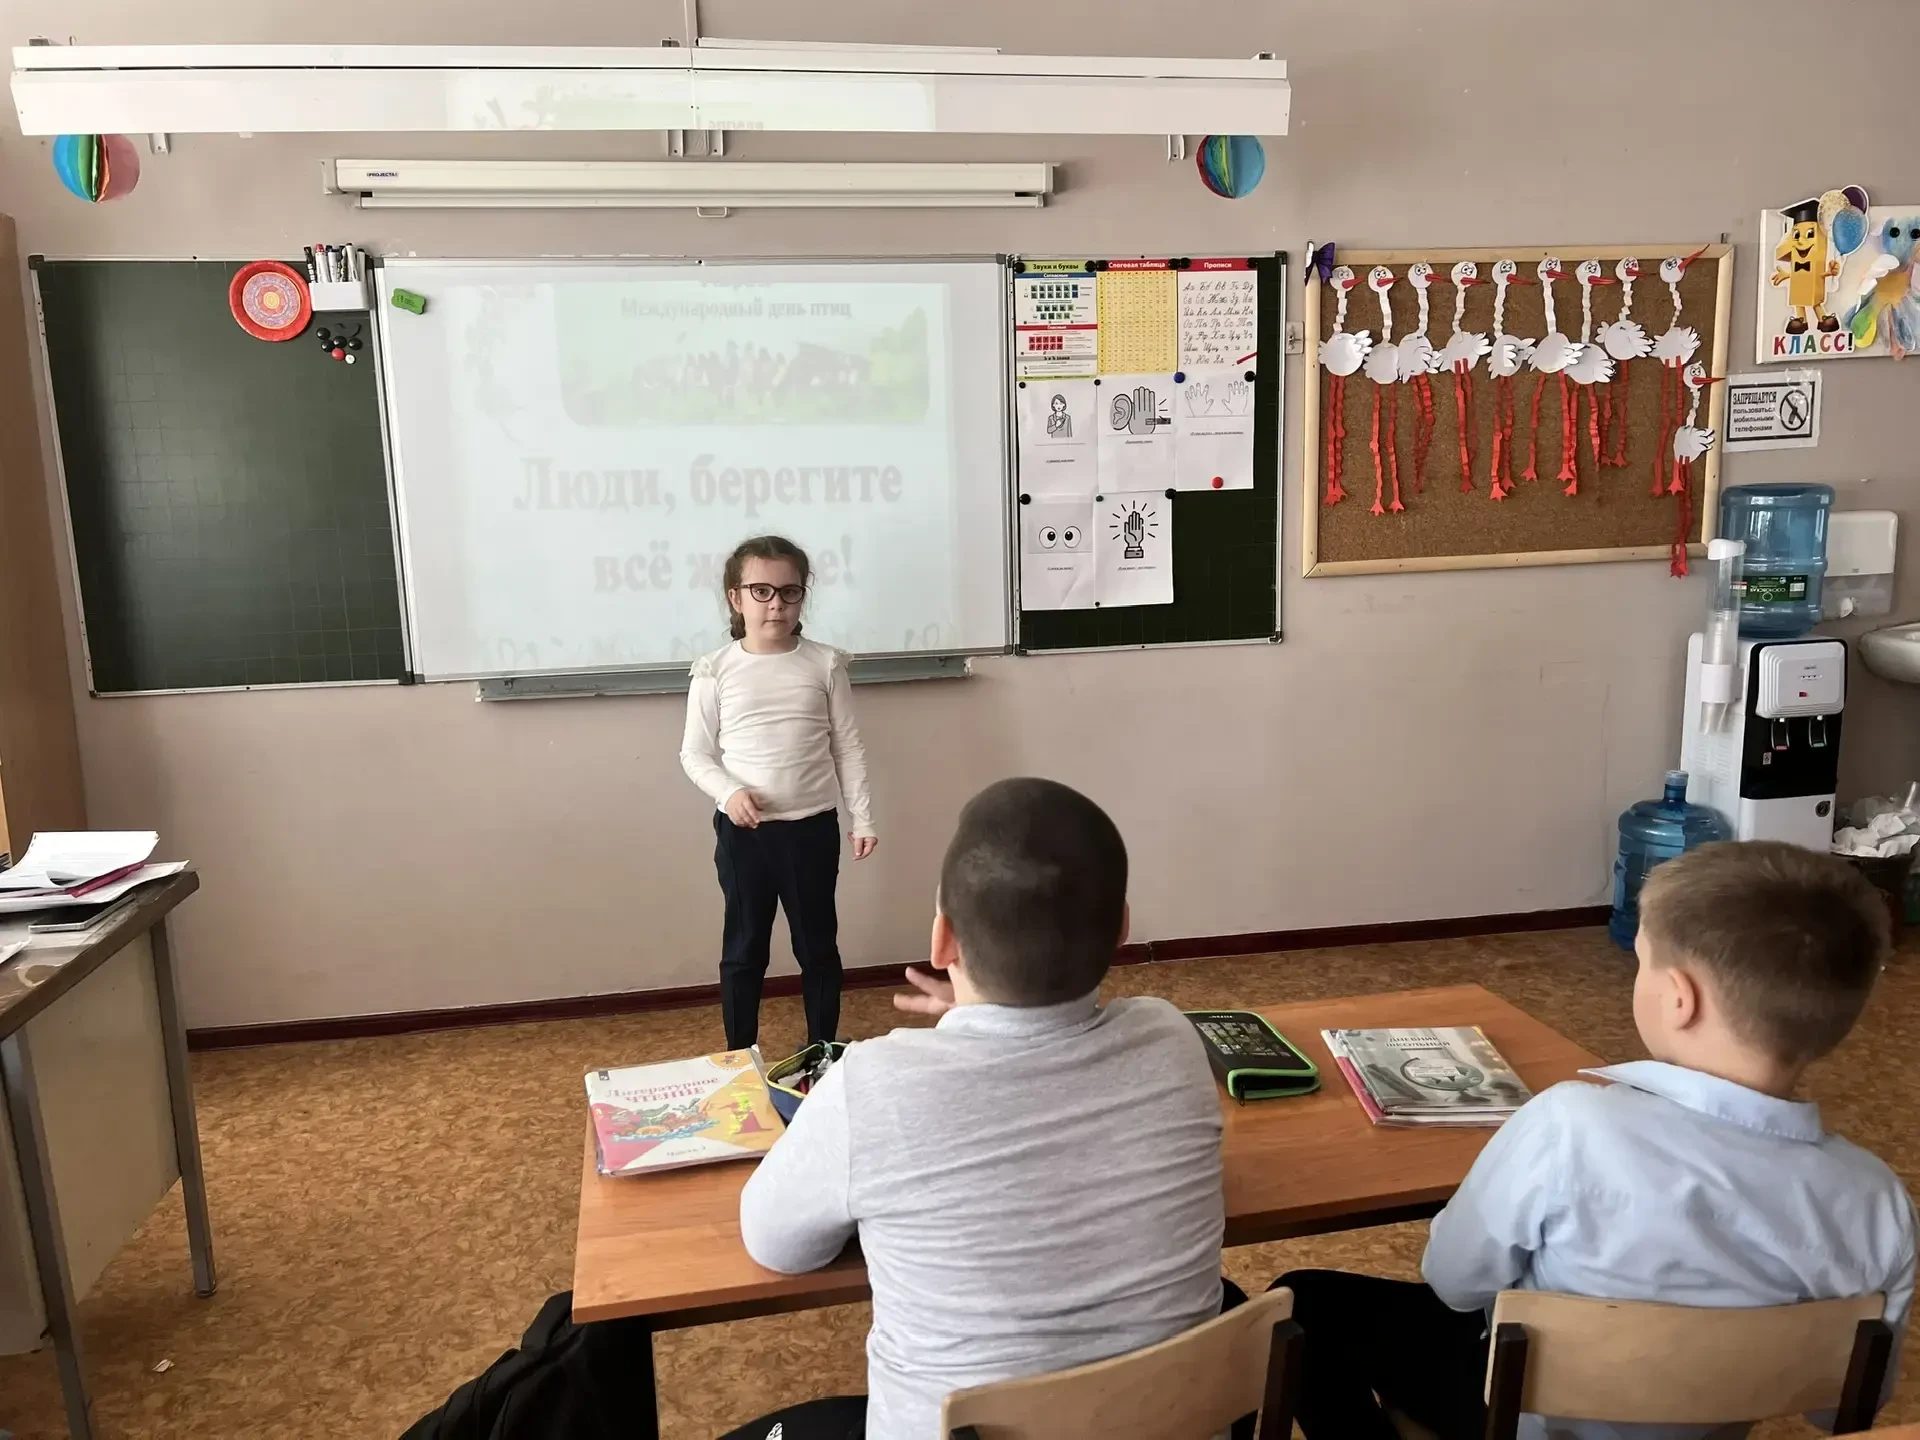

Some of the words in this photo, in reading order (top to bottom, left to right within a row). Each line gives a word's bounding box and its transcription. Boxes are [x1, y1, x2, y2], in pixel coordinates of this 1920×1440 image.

[1033, 263, 1052, 271] Звуки
[1058, 263, 1079, 271] буквы
[620, 295, 763, 324] Международный
[768, 301, 807, 319] день
[810, 301, 853, 320] птиц
[1773, 332, 1853, 355] КЛАСС!
[1732, 391, 1777, 405] ЗАПРЕЩАЕТСЯ
[1733, 415, 1774, 423] мобильными
[1734, 425, 1772, 433] телефонами
[513, 456, 676, 518] Люди,
[689, 453, 904, 519] берегите
[593, 539, 673, 592] всё
[688, 535, 855, 592] же!
[604, 1077, 719, 1098] Литературное
